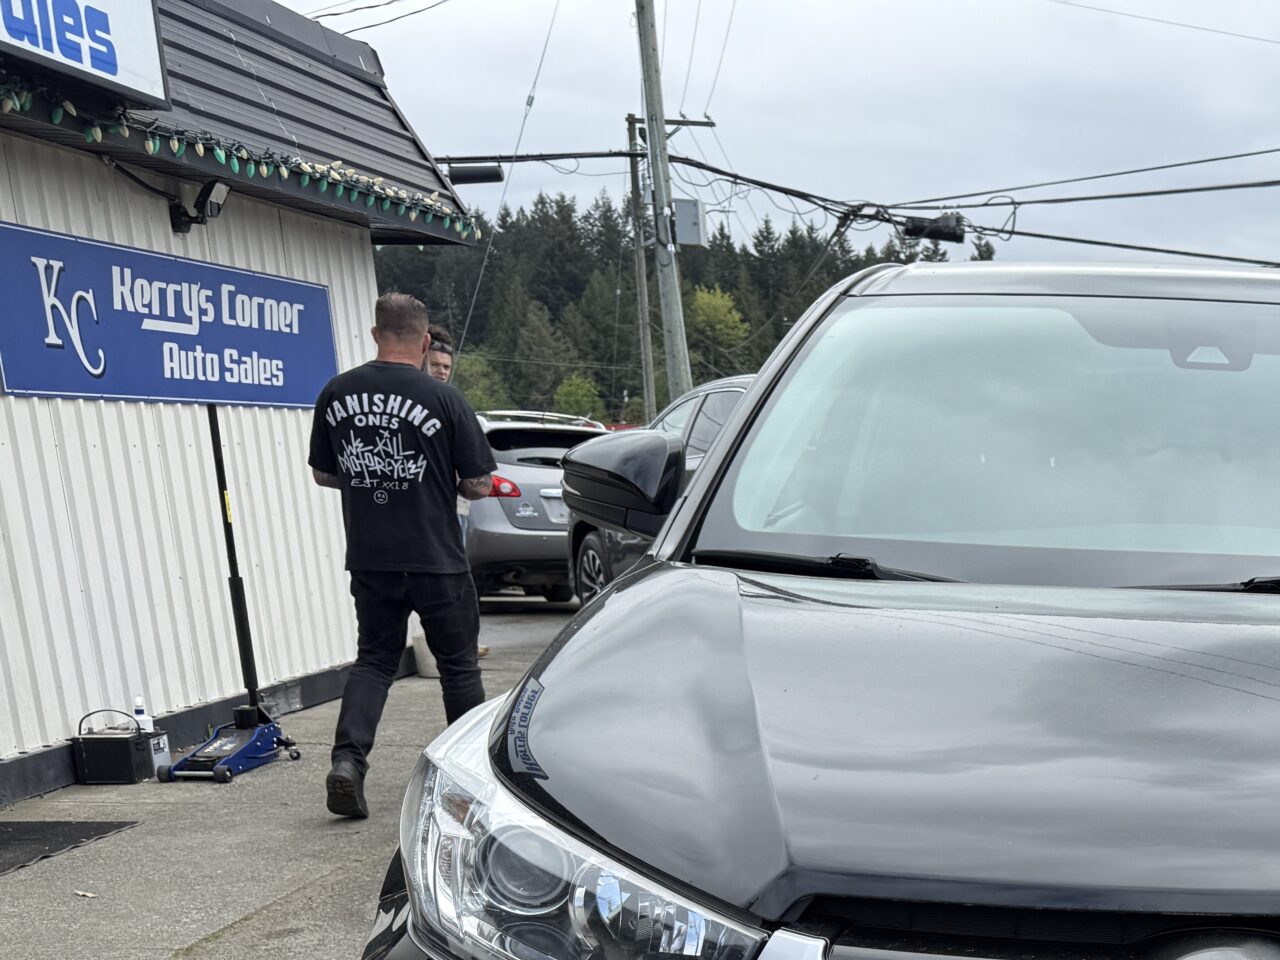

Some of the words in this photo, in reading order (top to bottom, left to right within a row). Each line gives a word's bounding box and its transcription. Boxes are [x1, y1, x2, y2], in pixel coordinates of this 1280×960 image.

[30, 256, 106, 376] KC
[221, 283, 304, 335] Corner
[163, 341, 220, 382] Auto
[223, 348, 284, 386] Sales
[325, 392, 442, 438] VANISHING
[354, 414, 400, 430] ONES
